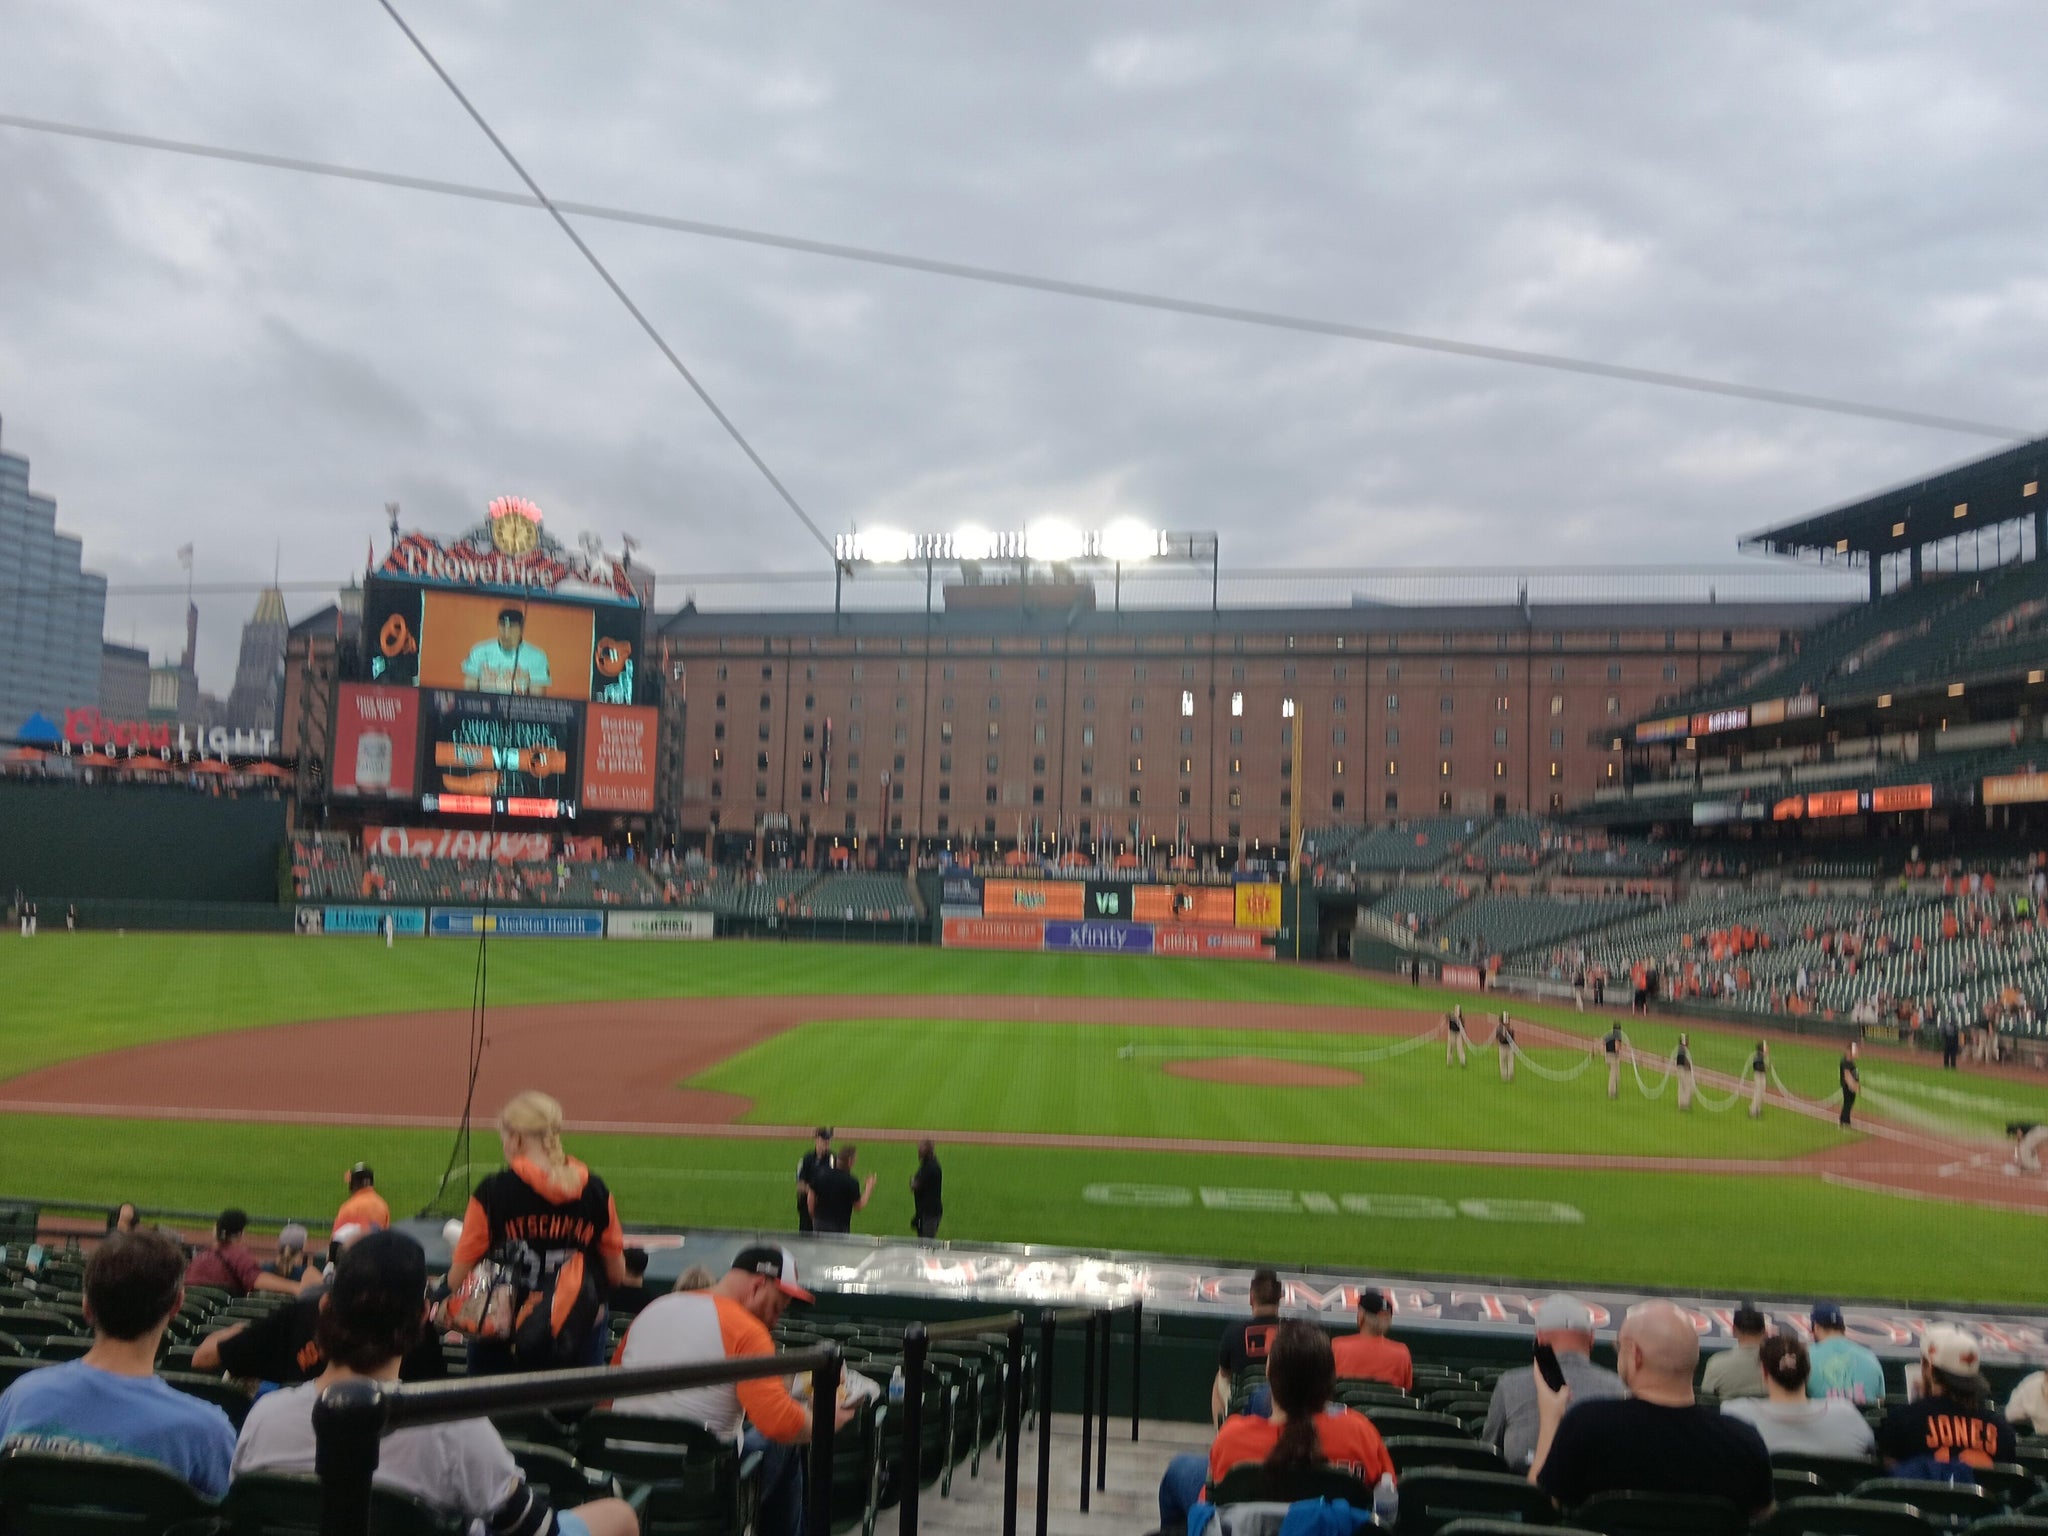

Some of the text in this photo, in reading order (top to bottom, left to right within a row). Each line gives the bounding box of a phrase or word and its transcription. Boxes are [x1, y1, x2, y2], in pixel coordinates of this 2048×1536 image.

[178, 723, 275, 756] LIGHT
[549, 917, 586, 933] Health
[1070, 922, 1127, 950] xfinity
[1926, 1414, 1998, 1457] JONES
